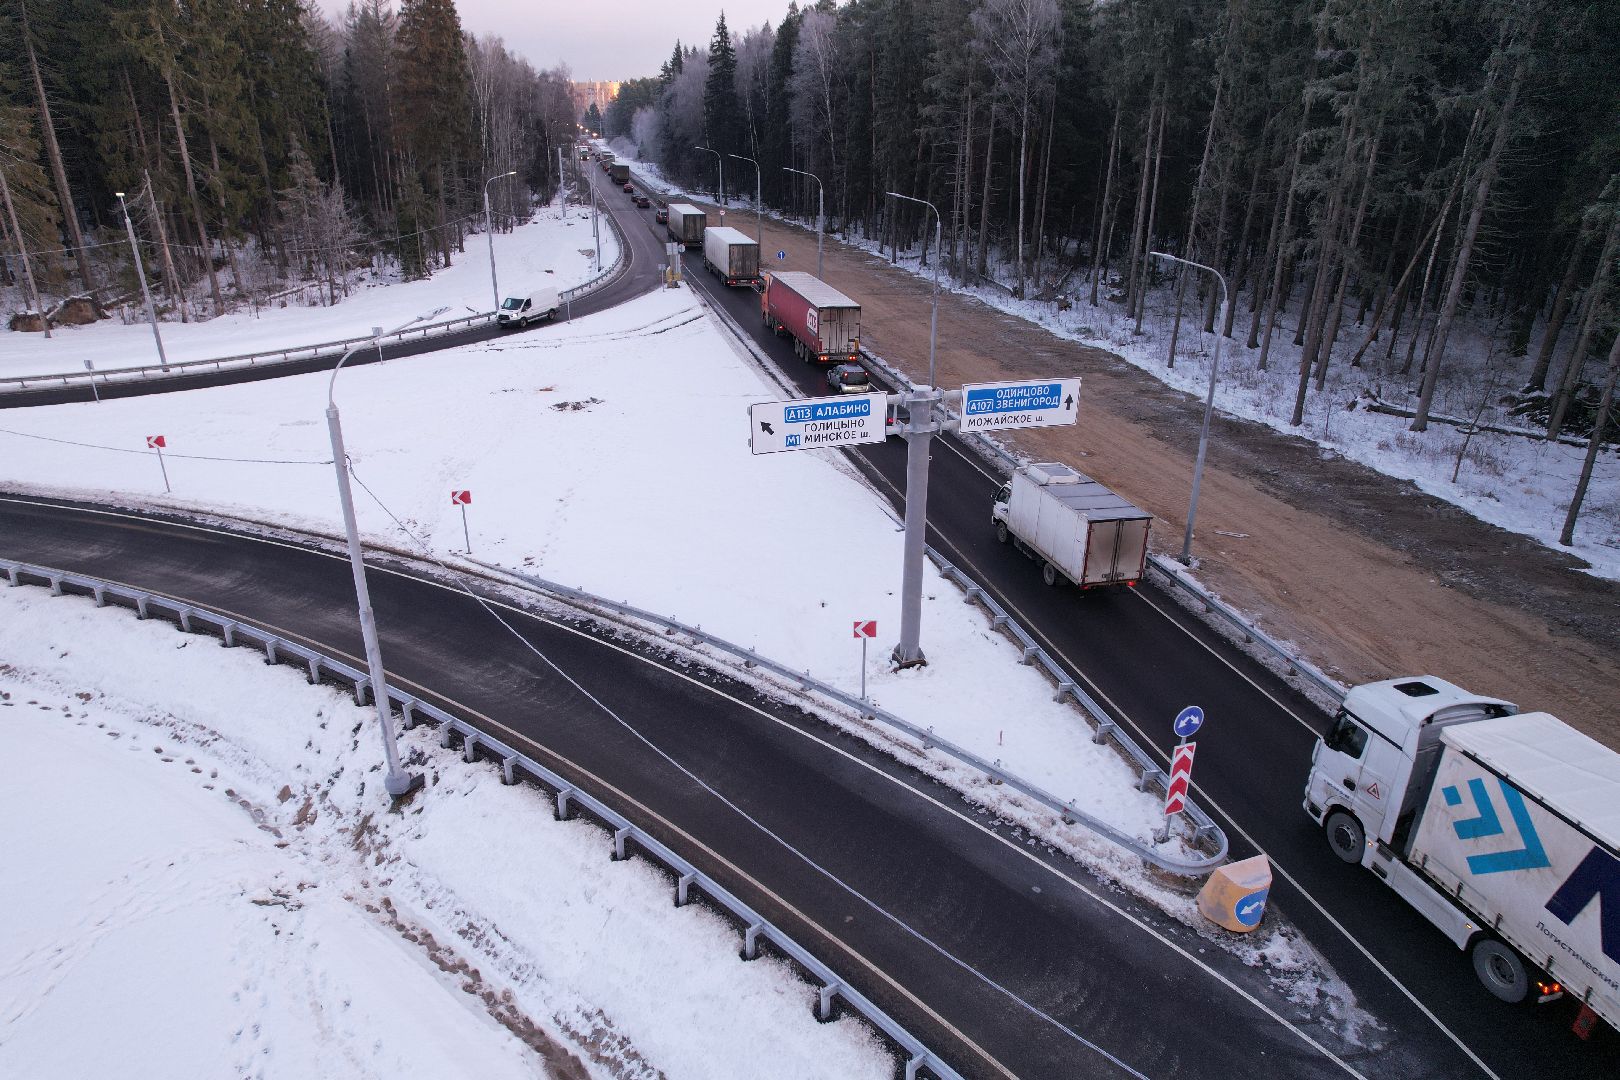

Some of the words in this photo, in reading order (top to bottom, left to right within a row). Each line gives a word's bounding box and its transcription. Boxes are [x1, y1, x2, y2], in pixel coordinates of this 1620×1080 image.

[997, 386, 1050, 399] ОДИНЦОВО
[970, 401, 992, 411] А107
[995, 396, 1059, 409] ЗВЕНИГОРОД
[788, 409, 811, 420] А113
[816, 403, 869, 417] АЛАБИНО
[804, 418, 865, 433] ГОЛИЦЫНО
[968, 414, 1032, 427] МОЖАЙСКОЕ
[786, 435, 800, 446] М1
[804, 431, 856, 444] МИНСКОЕ
[1535, 920, 1619, 990] Логистический
